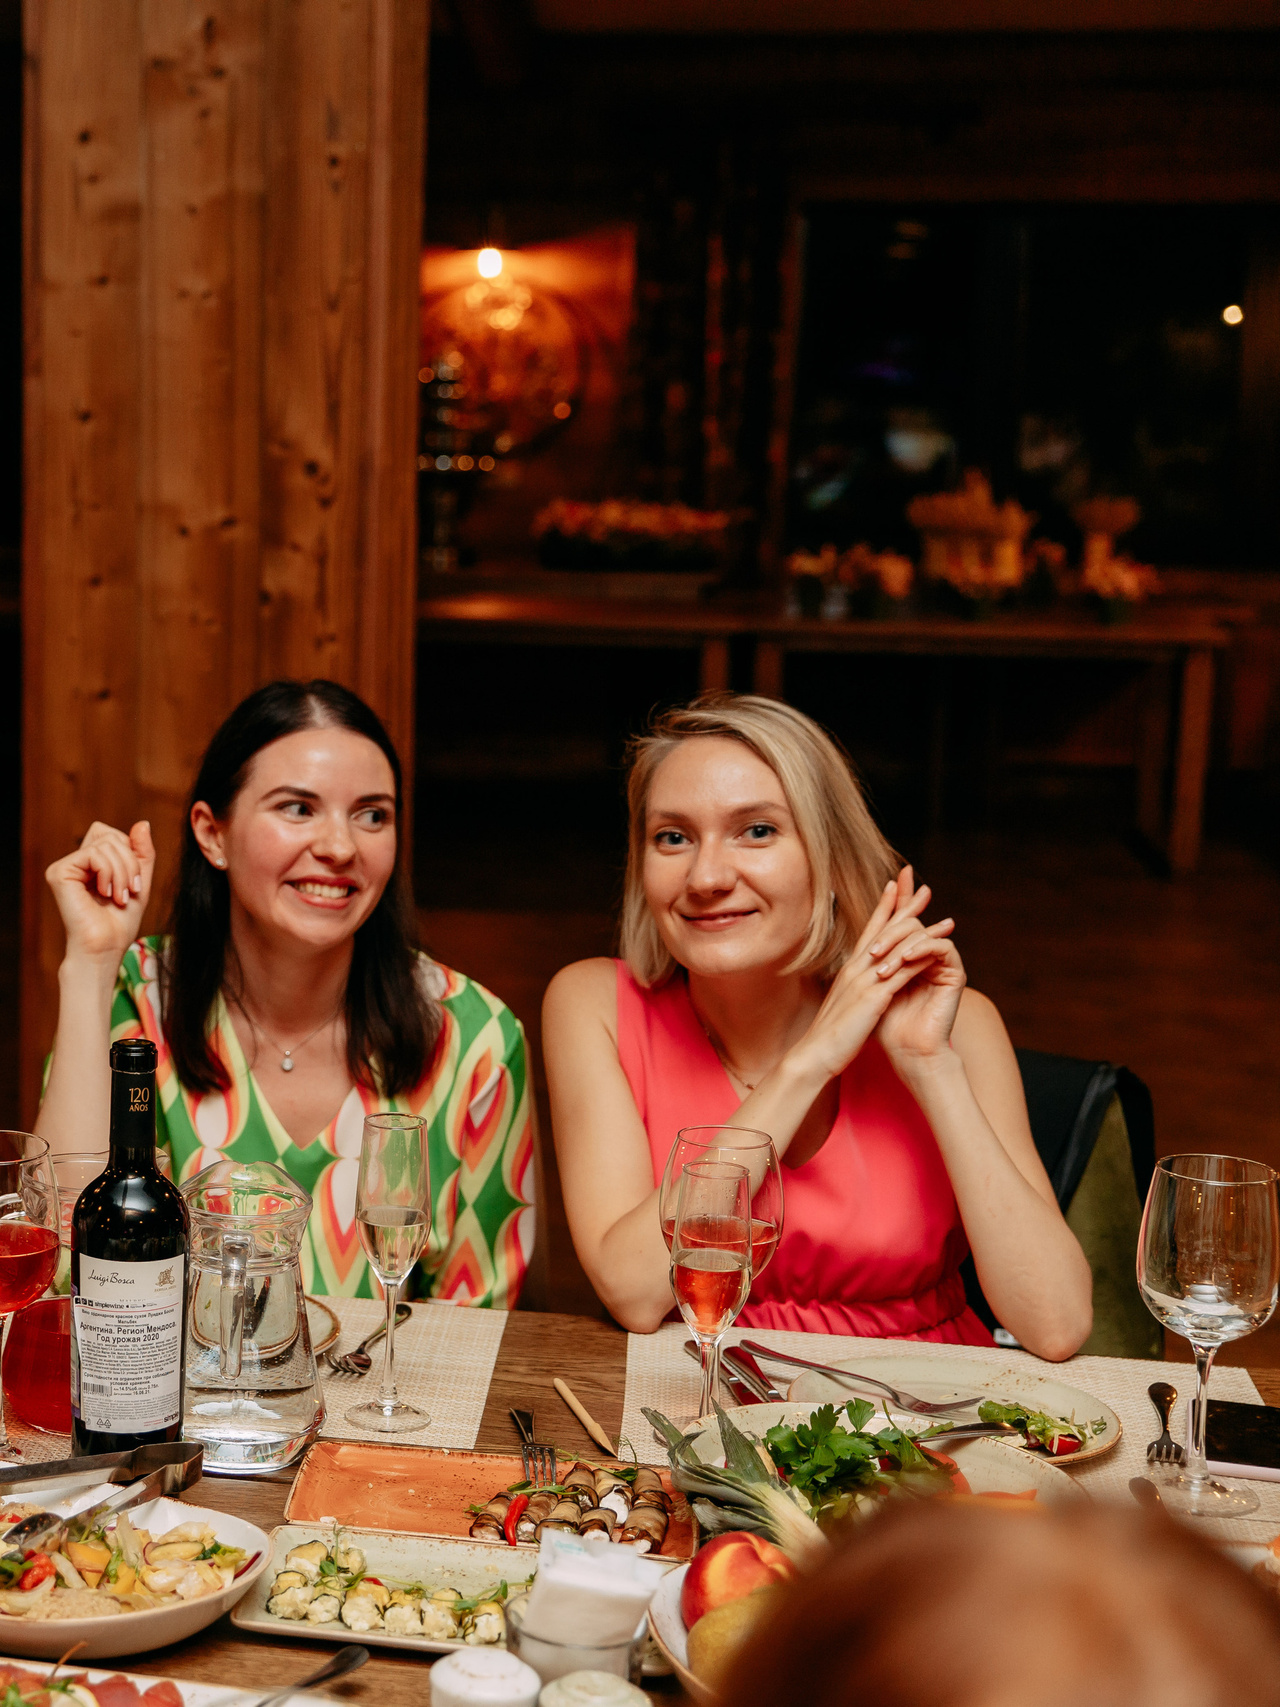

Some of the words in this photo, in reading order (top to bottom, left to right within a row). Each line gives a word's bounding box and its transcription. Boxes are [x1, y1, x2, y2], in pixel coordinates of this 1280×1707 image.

[129, 1087, 150, 1103] 120
[129, 1103, 148, 1112] AÑOS
[88, 1269, 109, 1286] Luigi
[110, 1272, 135, 1284] Bosca
[94, 1301, 124, 1309] simplewine
[80, 1321, 115, 1335] Аргентина.
[117, 1327, 145, 1335] Регион
[147, 1321, 177, 1333] Мендоса.
[97, 1333, 110, 1343] Год
[112, 1336, 140, 1345] урожая
[143, 1332, 160, 1342] 2020
